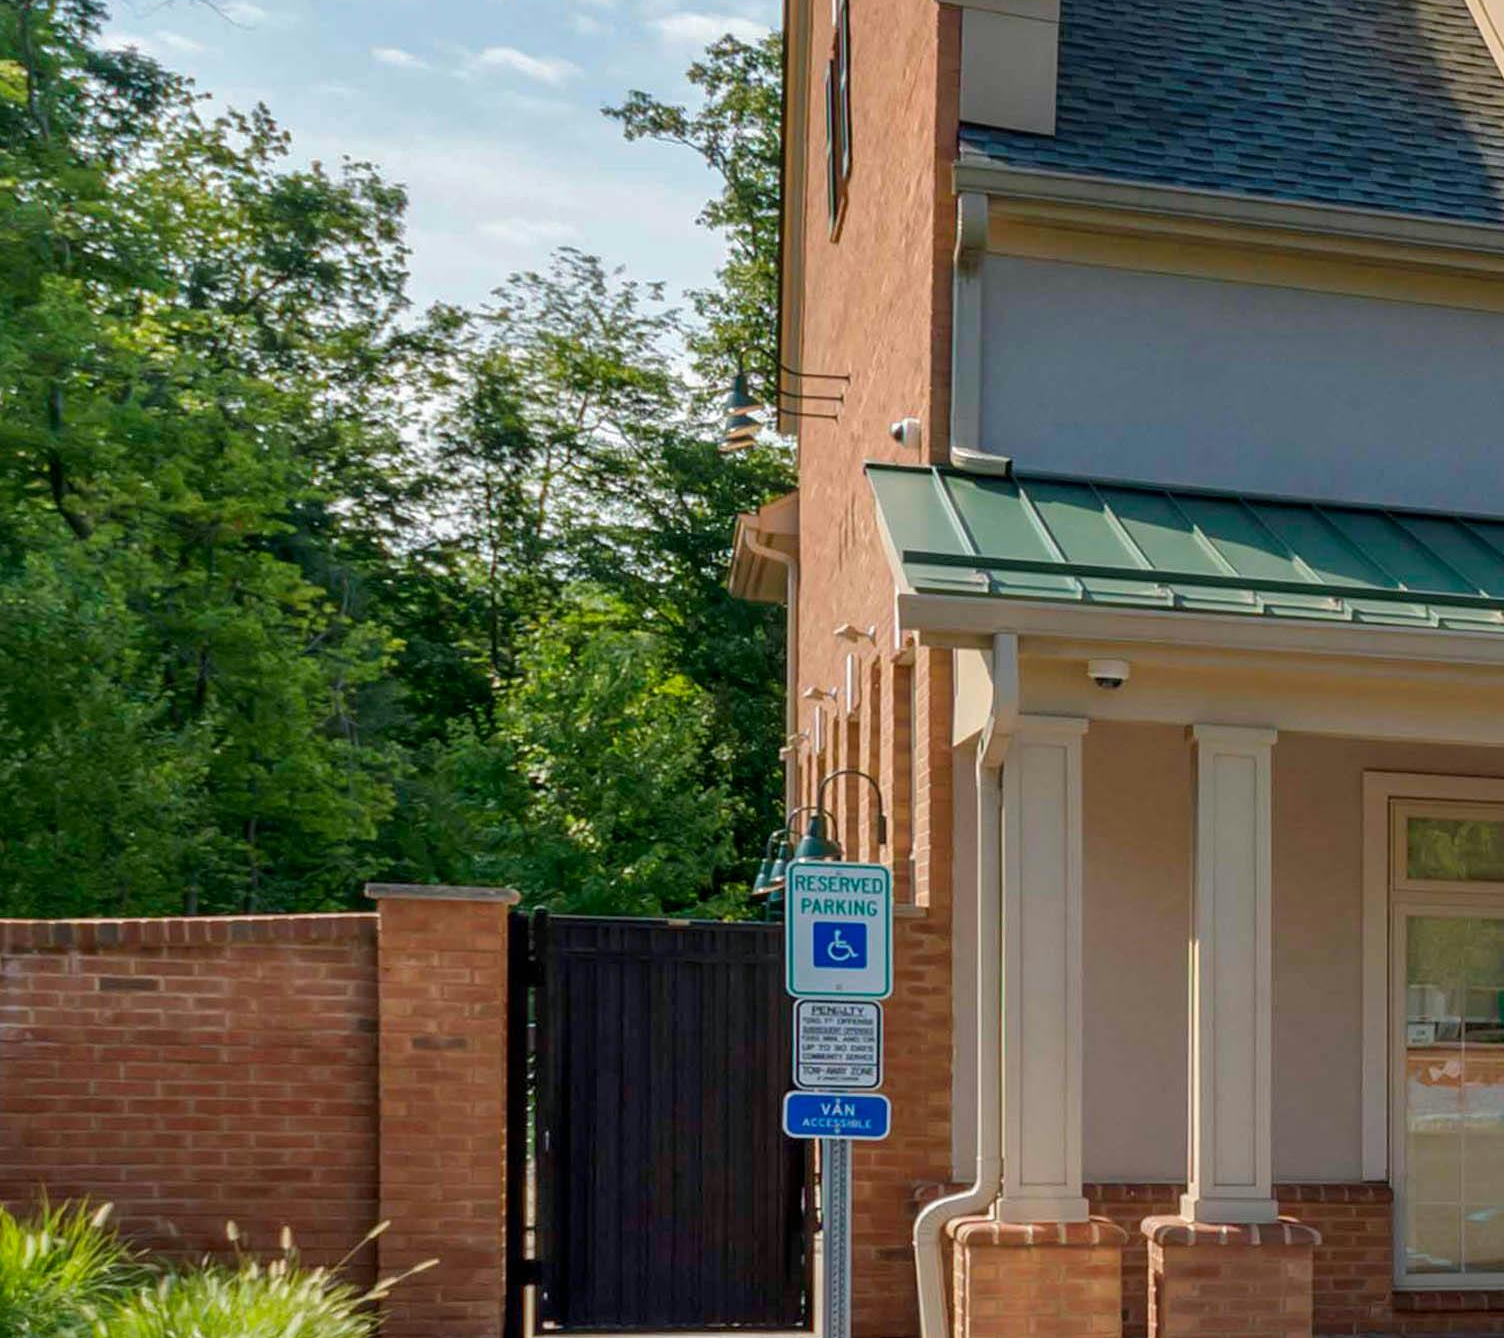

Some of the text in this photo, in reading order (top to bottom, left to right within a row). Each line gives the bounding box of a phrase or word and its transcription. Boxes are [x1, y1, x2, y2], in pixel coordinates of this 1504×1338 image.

[795, 875, 884, 894] RESERVED
[801, 897, 878, 917] PARKING
[821, 1103, 856, 1117] VAN
[801, 1117, 872, 1129] ACCESSIBLE
